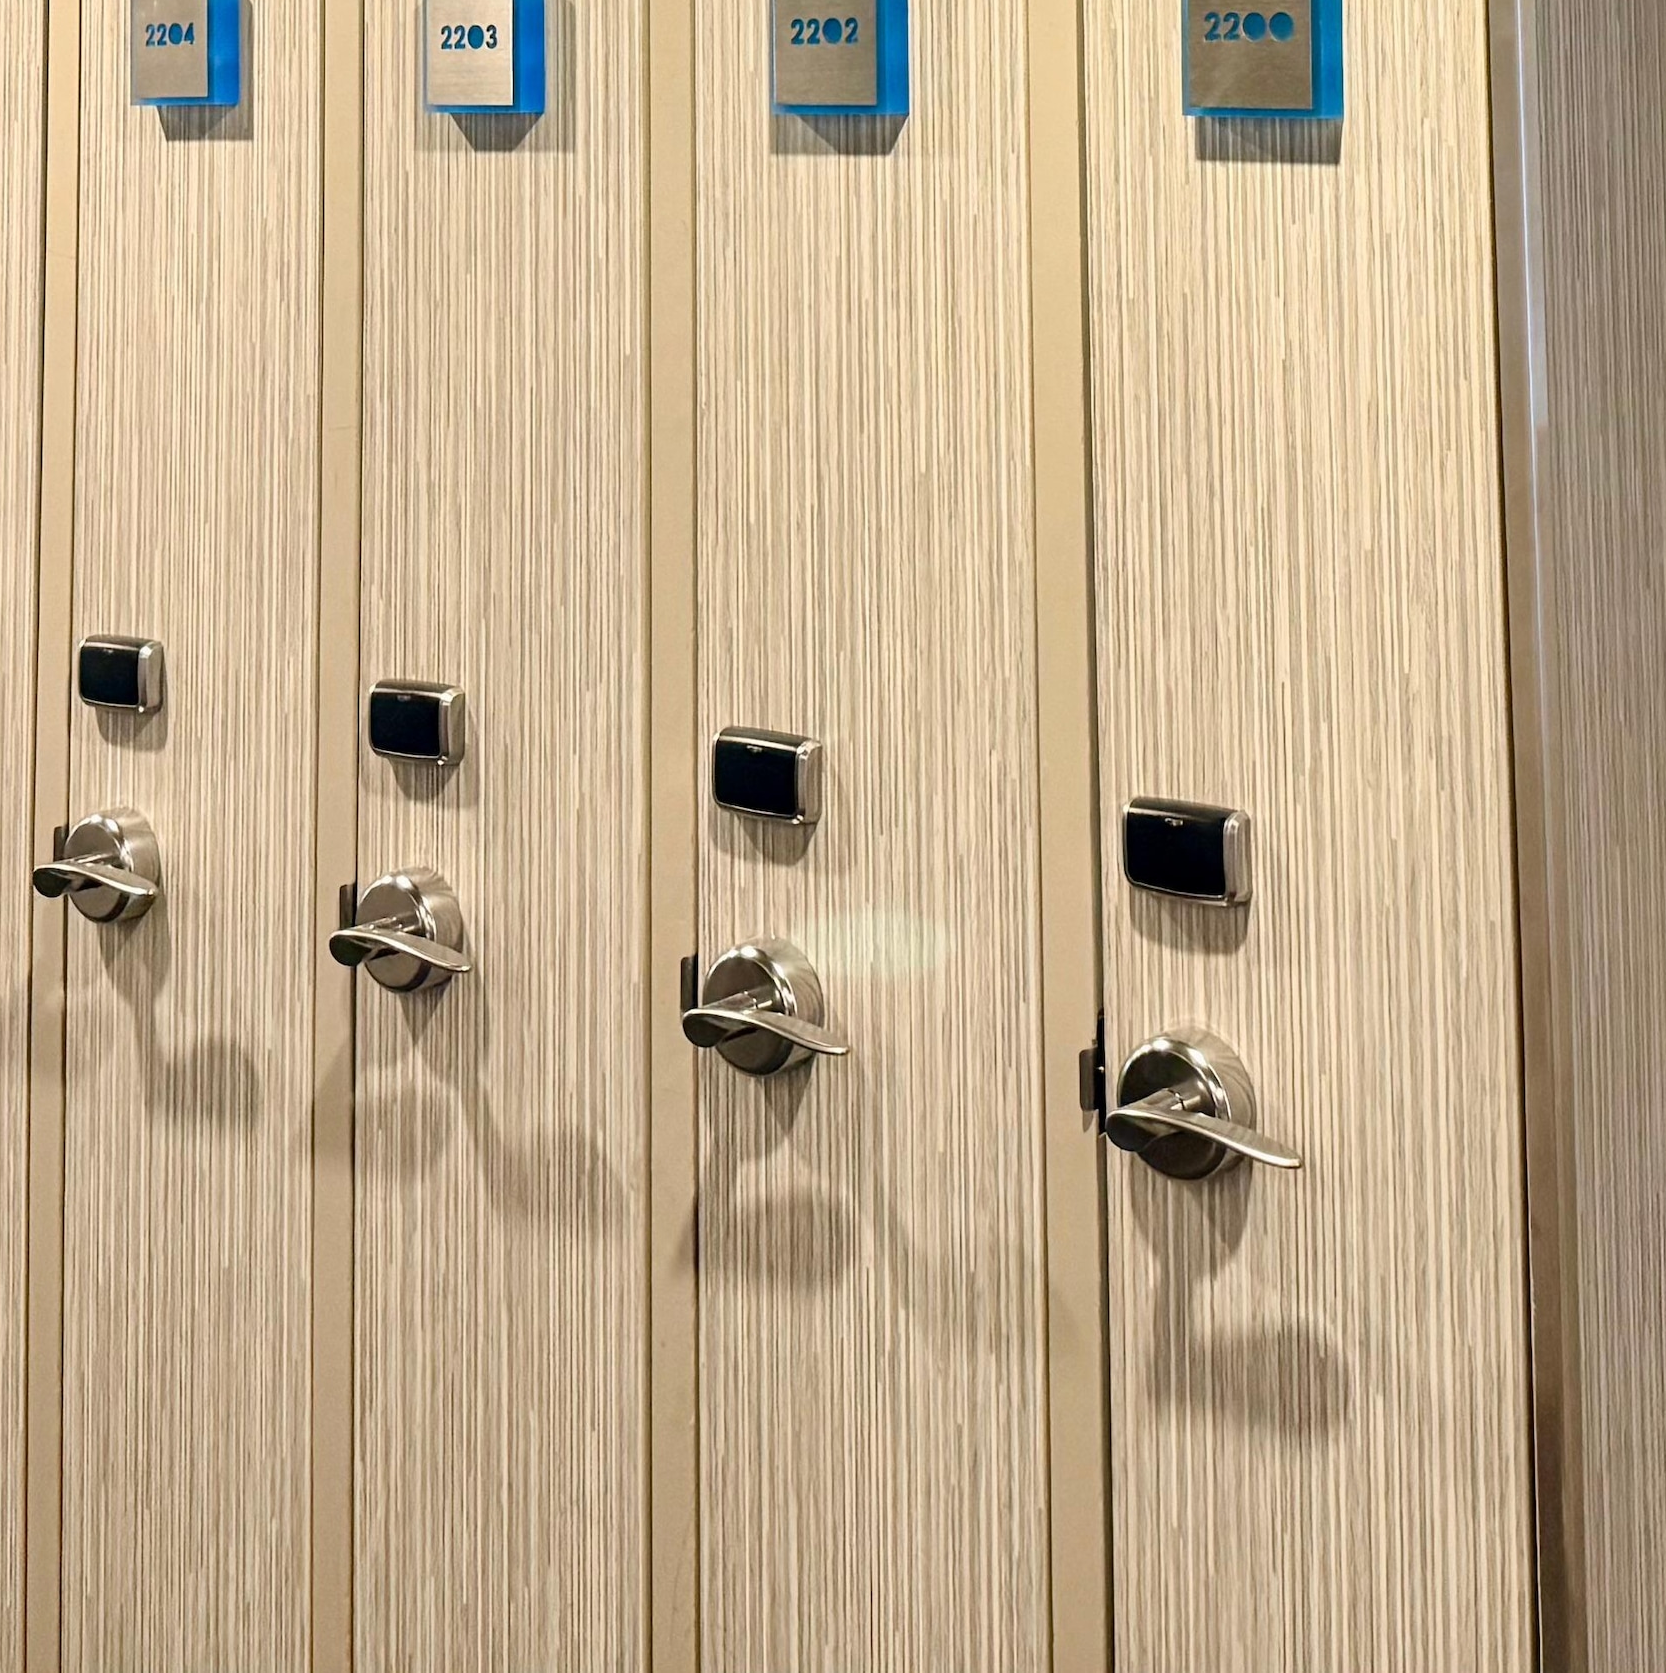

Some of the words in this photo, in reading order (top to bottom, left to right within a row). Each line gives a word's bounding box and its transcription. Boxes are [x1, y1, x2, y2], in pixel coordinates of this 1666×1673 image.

[145, 22, 195, 47] 2204
[440, 23, 498, 50] 2203
[790, 16, 859, 45] 2202
[1203, 11, 1294, 42] 2200
